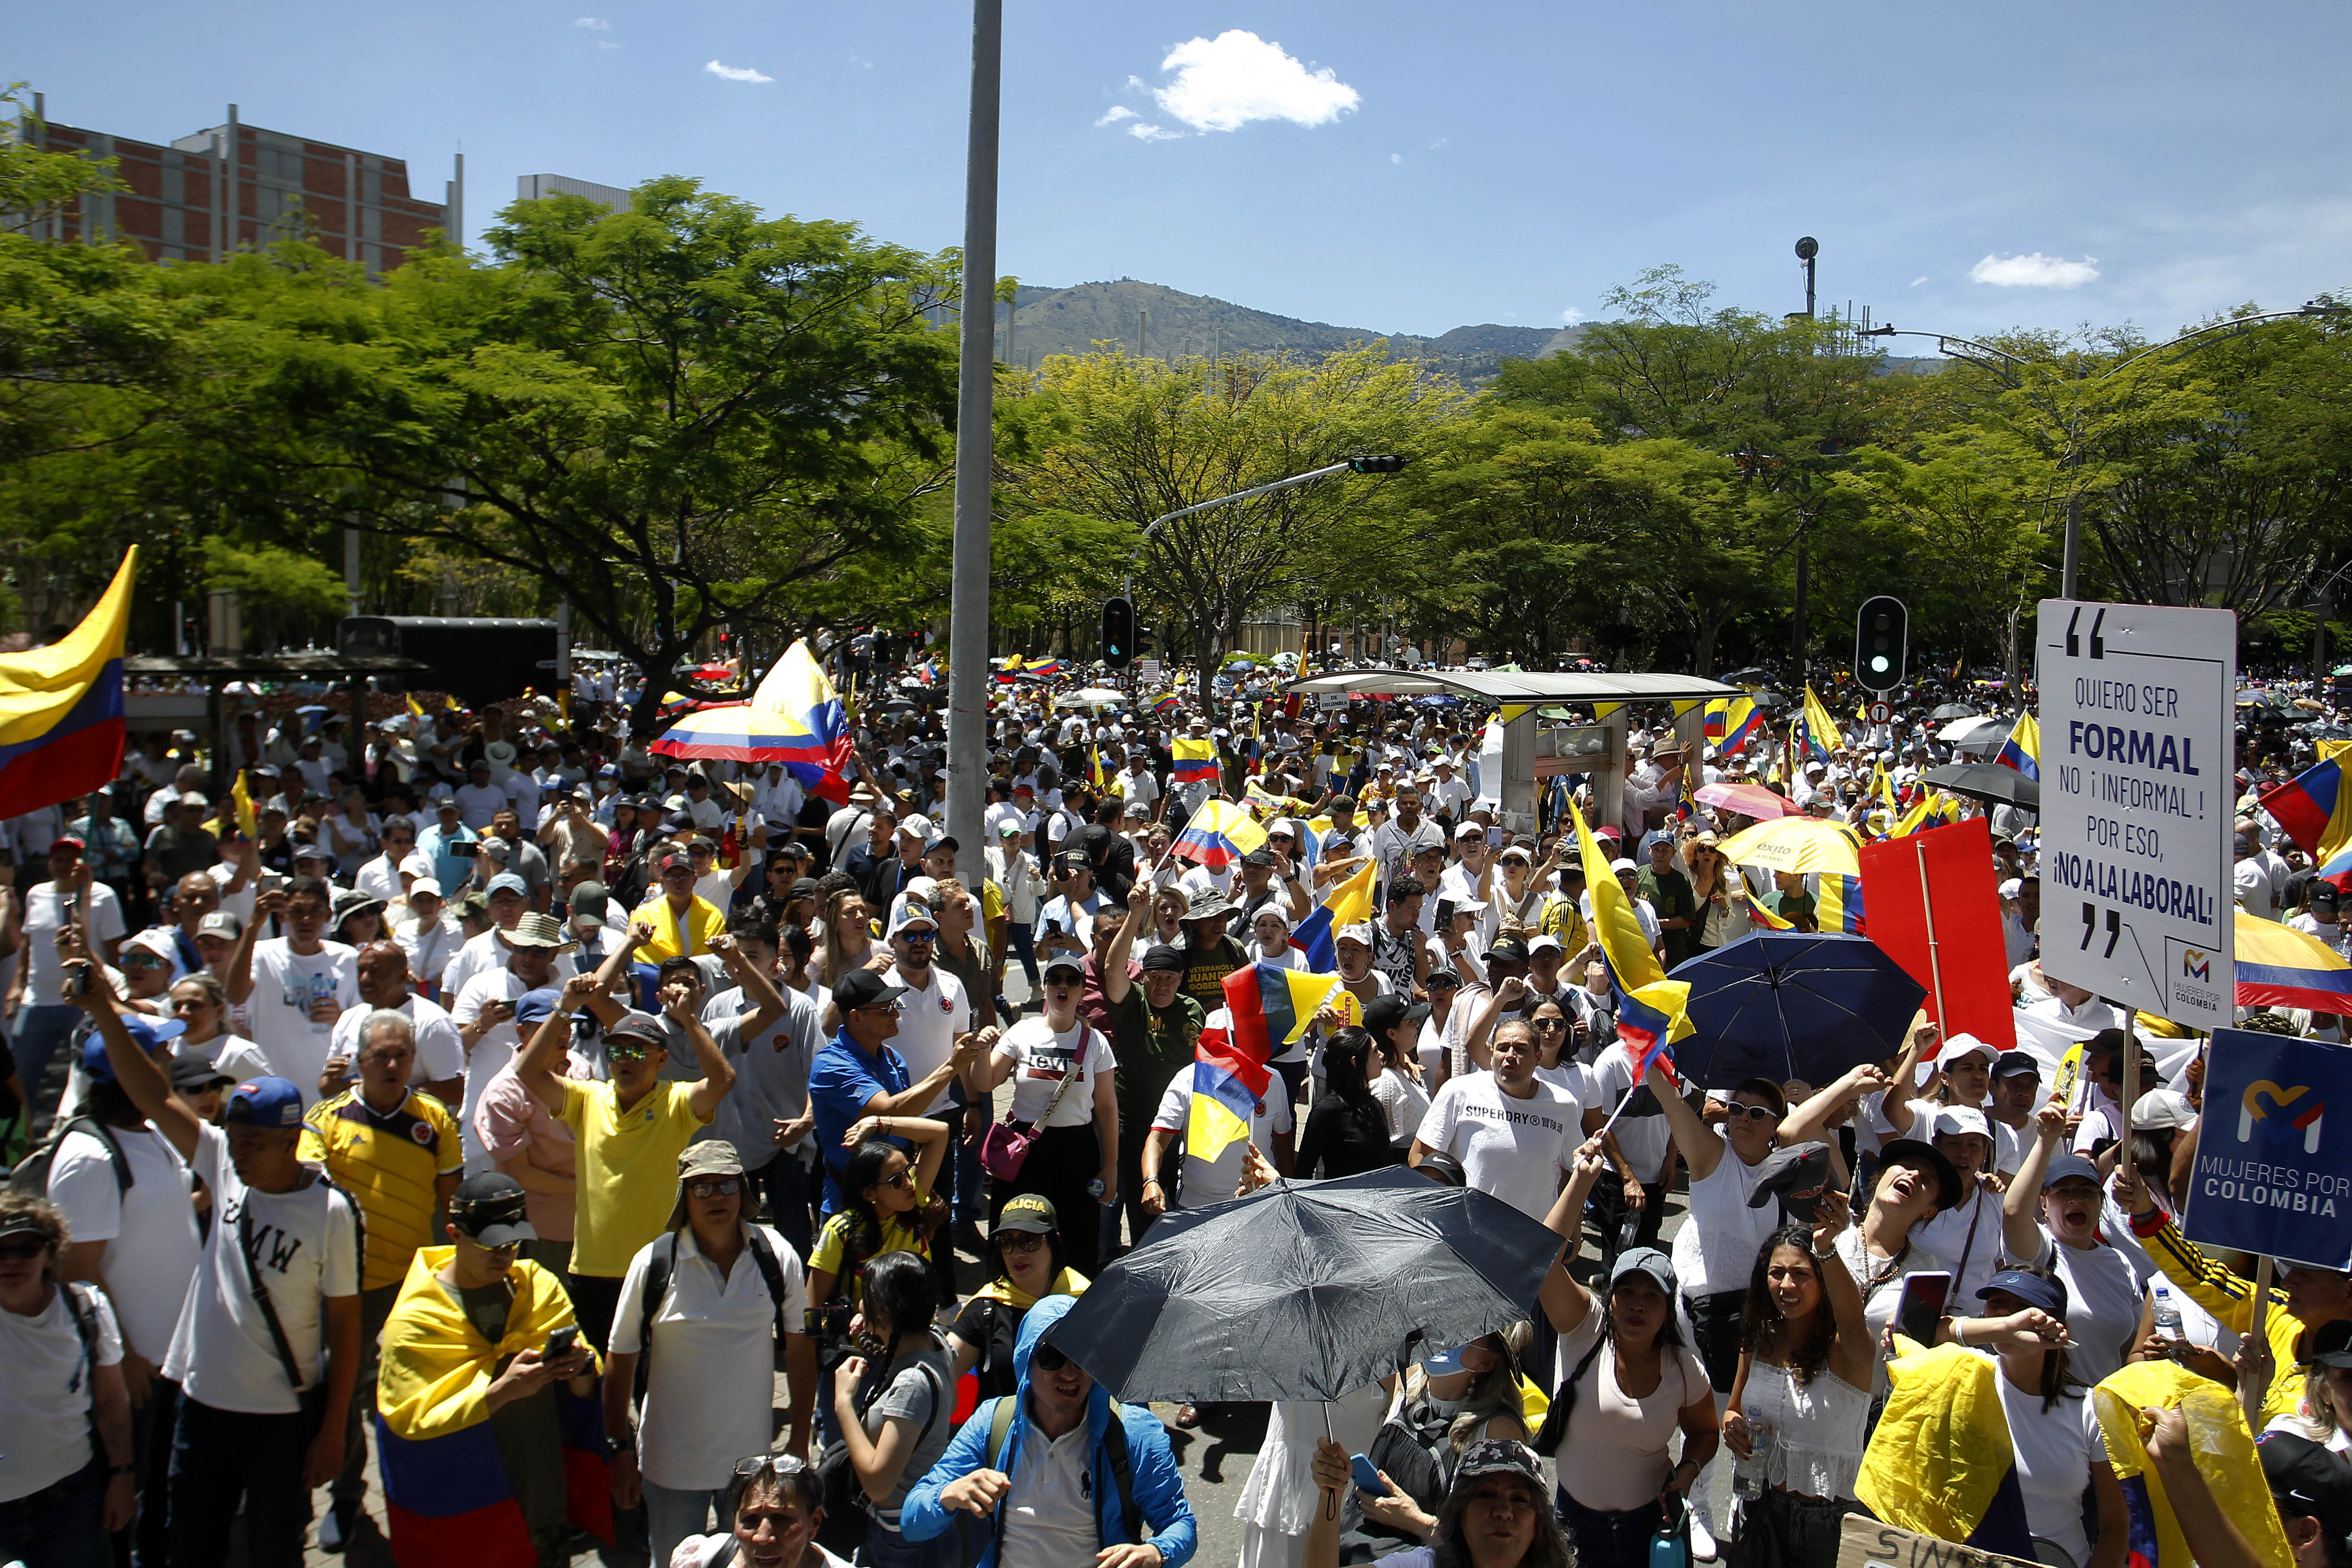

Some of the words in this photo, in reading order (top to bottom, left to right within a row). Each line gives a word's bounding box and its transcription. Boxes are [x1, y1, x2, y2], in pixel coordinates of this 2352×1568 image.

[2075, 677, 2135, 712] QUIERO
[2142, 686, 2178, 719] SER
[2069, 720, 2199, 776] FORMAL
[2059, 764, 2080, 795] NO
[1757, 842, 1791, 855] éxito
[2087, 815, 2119, 849] POR
[2125, 823, 2164, 863] ESO,
[2054, 851, 2081, 889] ¡NO
[2083, 859, 2095, 894] A
[2098, 862, 2118, 900] LA
[2121, 868, 2213, 926] LABORAL!
[1189, 965, 1229, 973] VETERANOS
[2174, 982, 2205, 999] MUJERES
[2206, 992, 2220, 1003] POR
[2176, 992, 2217, 1012] COLOMBIA
[2200, 1155, 2300, 1188] MUJERES
[2305, 1172, 2350, 1198] POR
[1001, 1199, 1046, 1215] POLICIA
[2204, 1178, 2336, 1218] COLOMBIA
